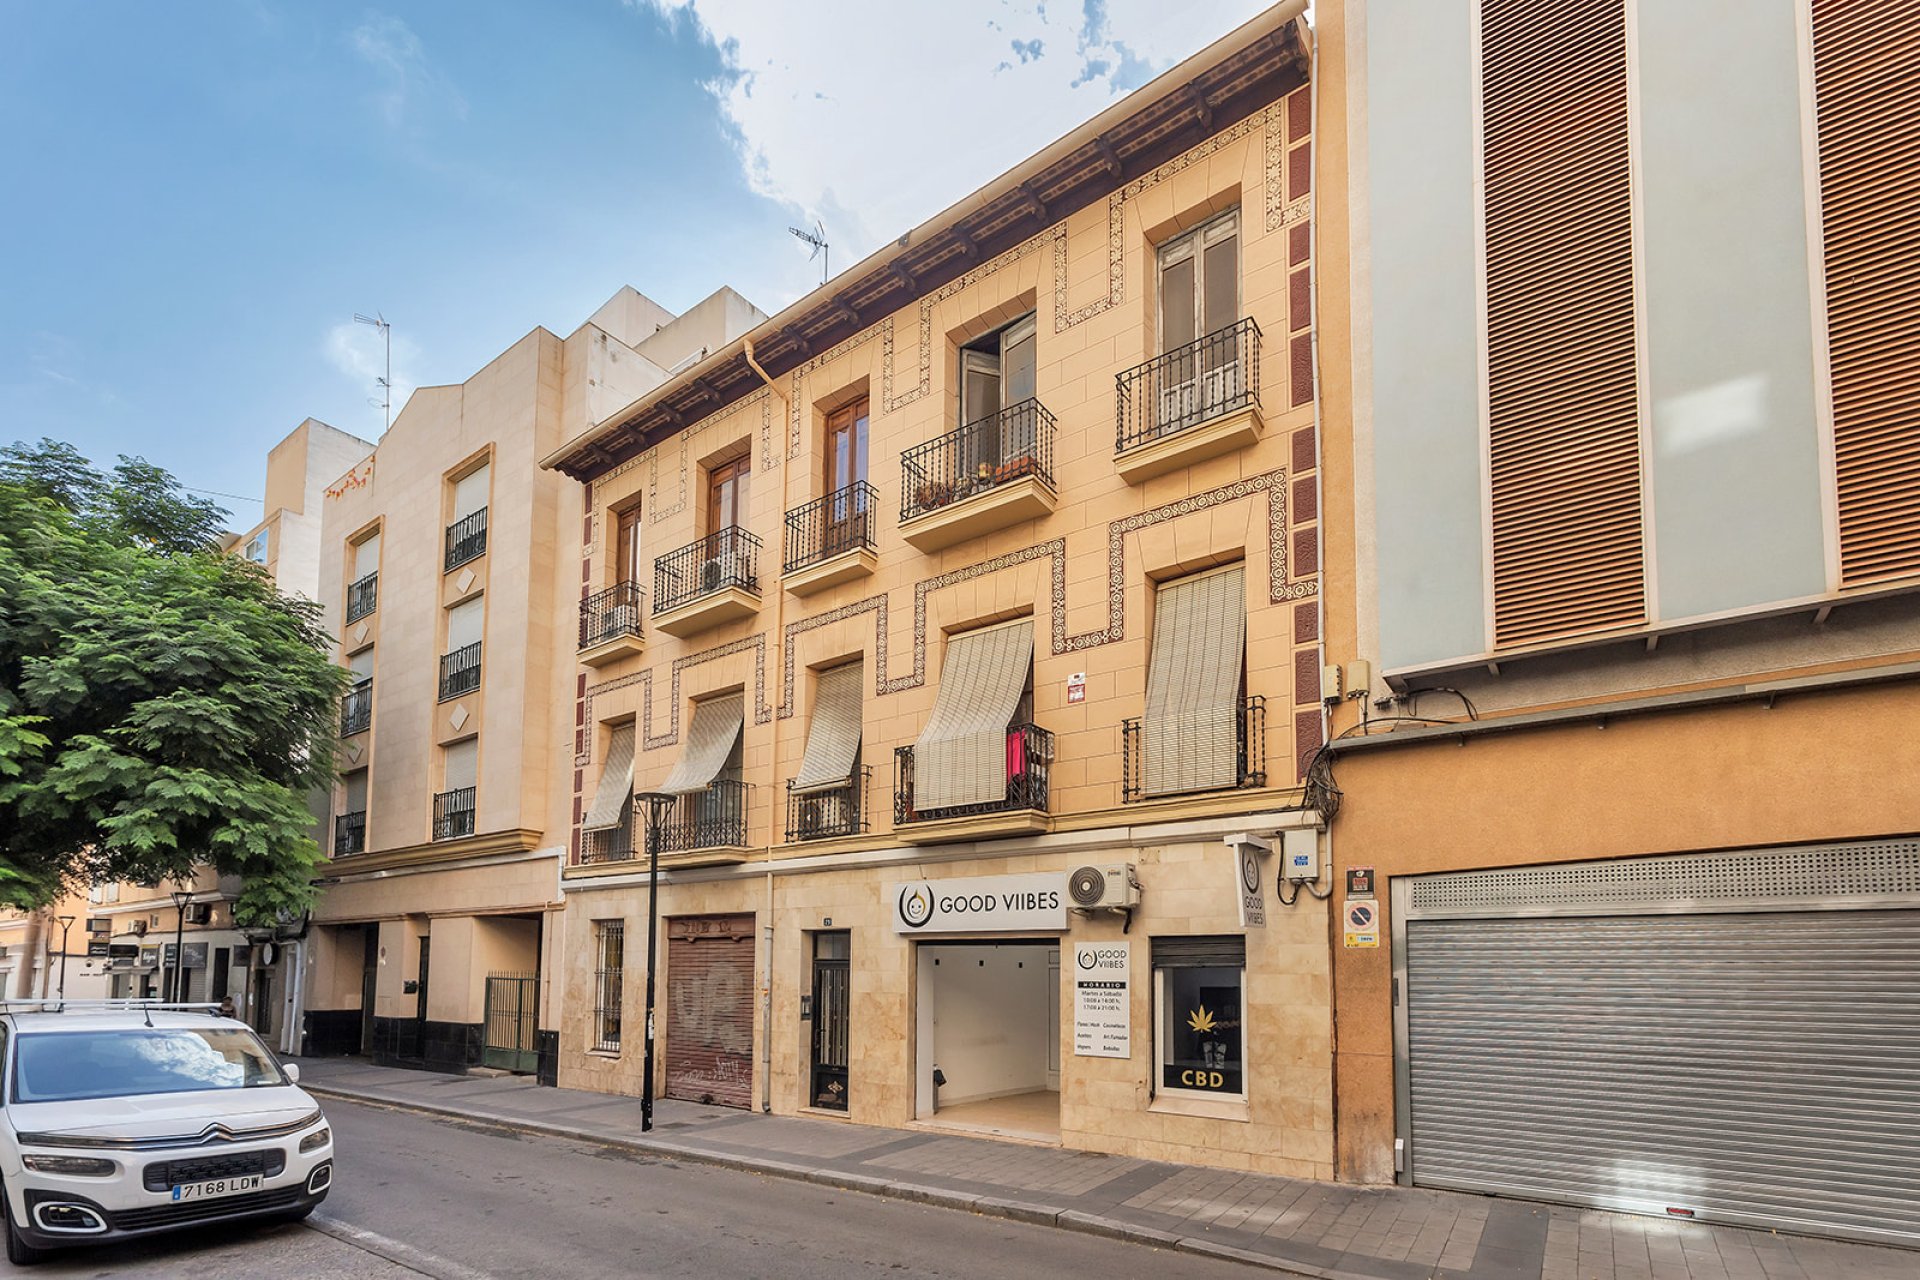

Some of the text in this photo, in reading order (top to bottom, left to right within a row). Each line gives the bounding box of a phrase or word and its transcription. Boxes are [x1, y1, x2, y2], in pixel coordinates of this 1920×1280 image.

[939, 890, 1060, 914] GOOD VIIBES
[1245, 895, 1262, 910] GOOD
[1097, 949, 1127, 959] GOOD
[1181, 1069, 1224, 1088] CBD
[184, 1176, 260, 1198] 7168 LDW
